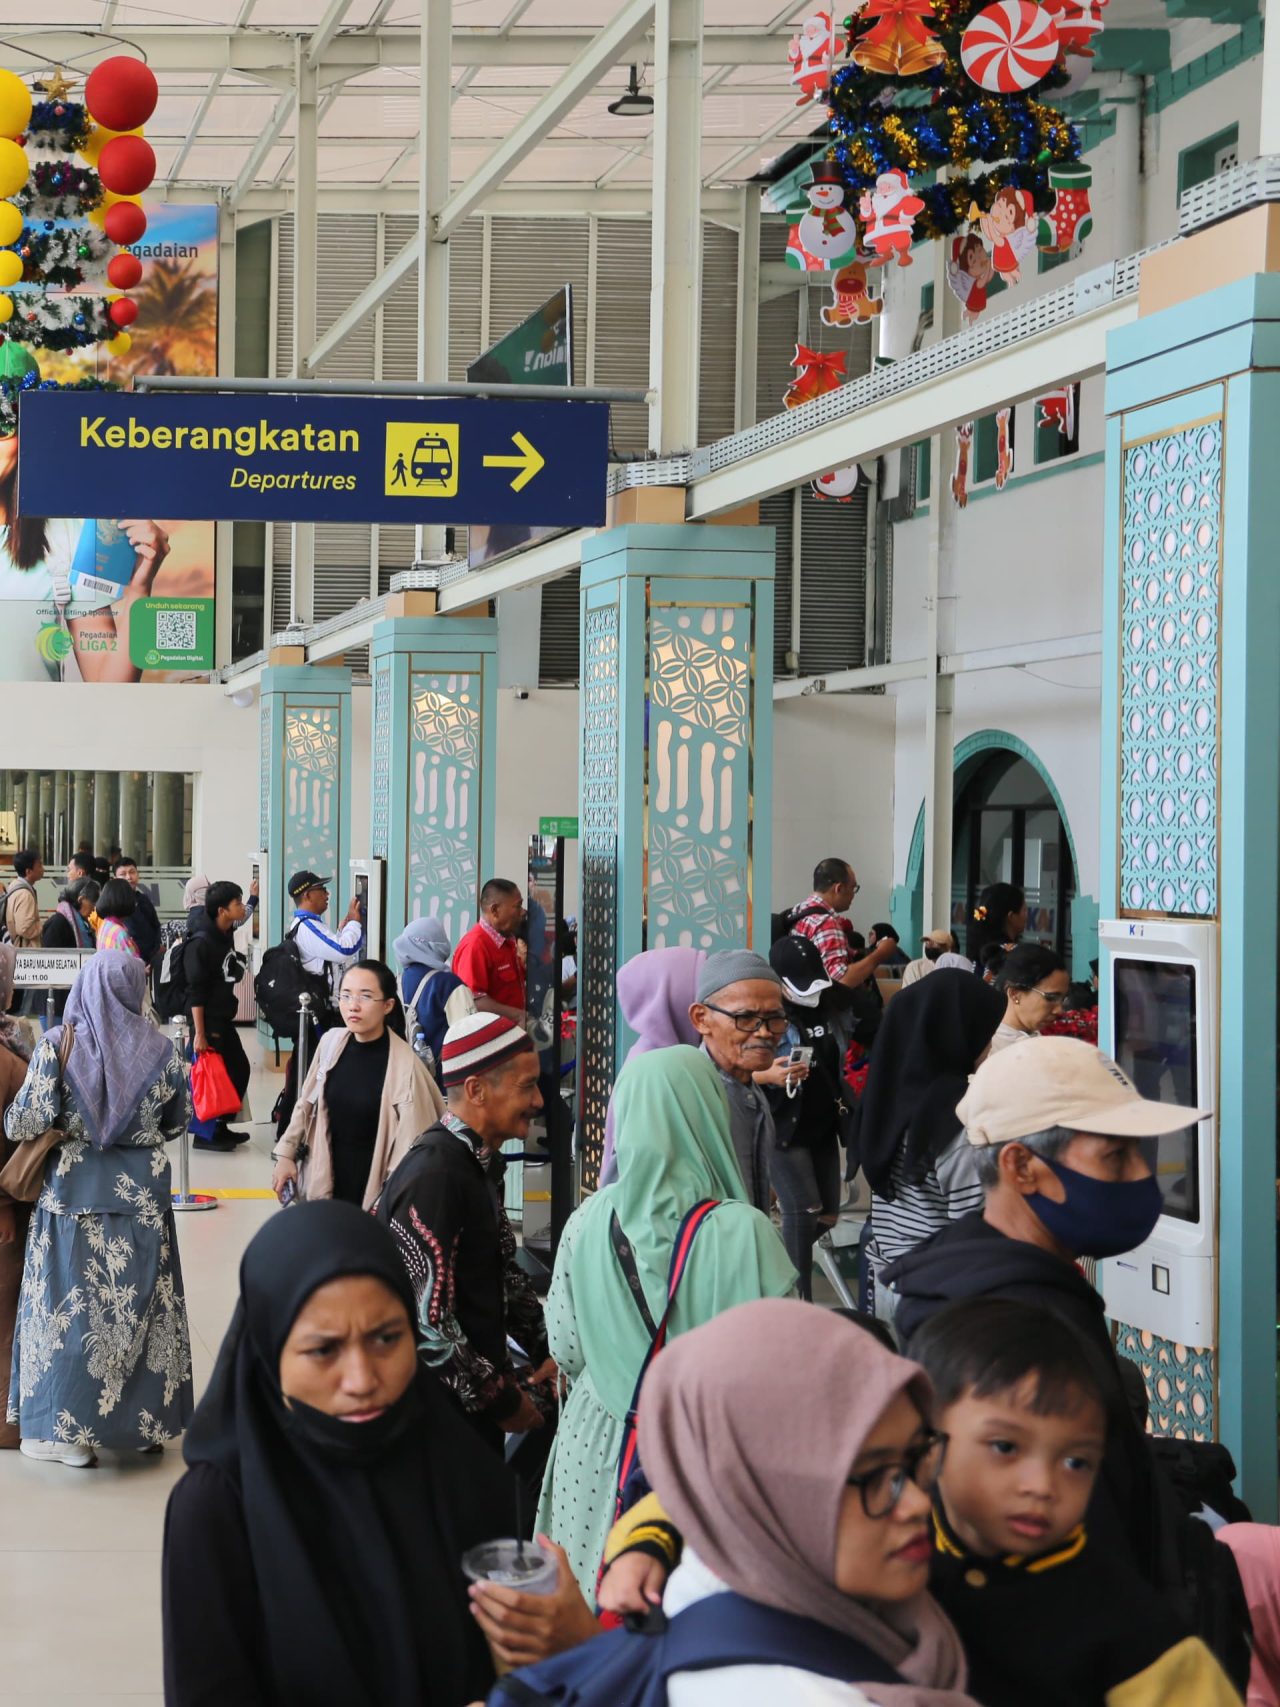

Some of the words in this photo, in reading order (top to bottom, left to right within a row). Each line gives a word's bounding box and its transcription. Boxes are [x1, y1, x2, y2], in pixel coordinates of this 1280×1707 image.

[80, 417, 359, 456] Keberangkatan
[230, 468, 357, 493] Departures
[145, 602, 170, 611] Unduh
[170, 603, 205, 611] sekarang
[80, 630, 118, 639] Pegadaian
[80, 640, 107, 651] LIGA
[111, 641, 118, 651] 2
[160, 654, 186, 662] Pegadaian
[23, 958, 35, 969] BARU
[36, 958, 55, 969] MALAM
[56, 958, 78, 970] SELATAN
